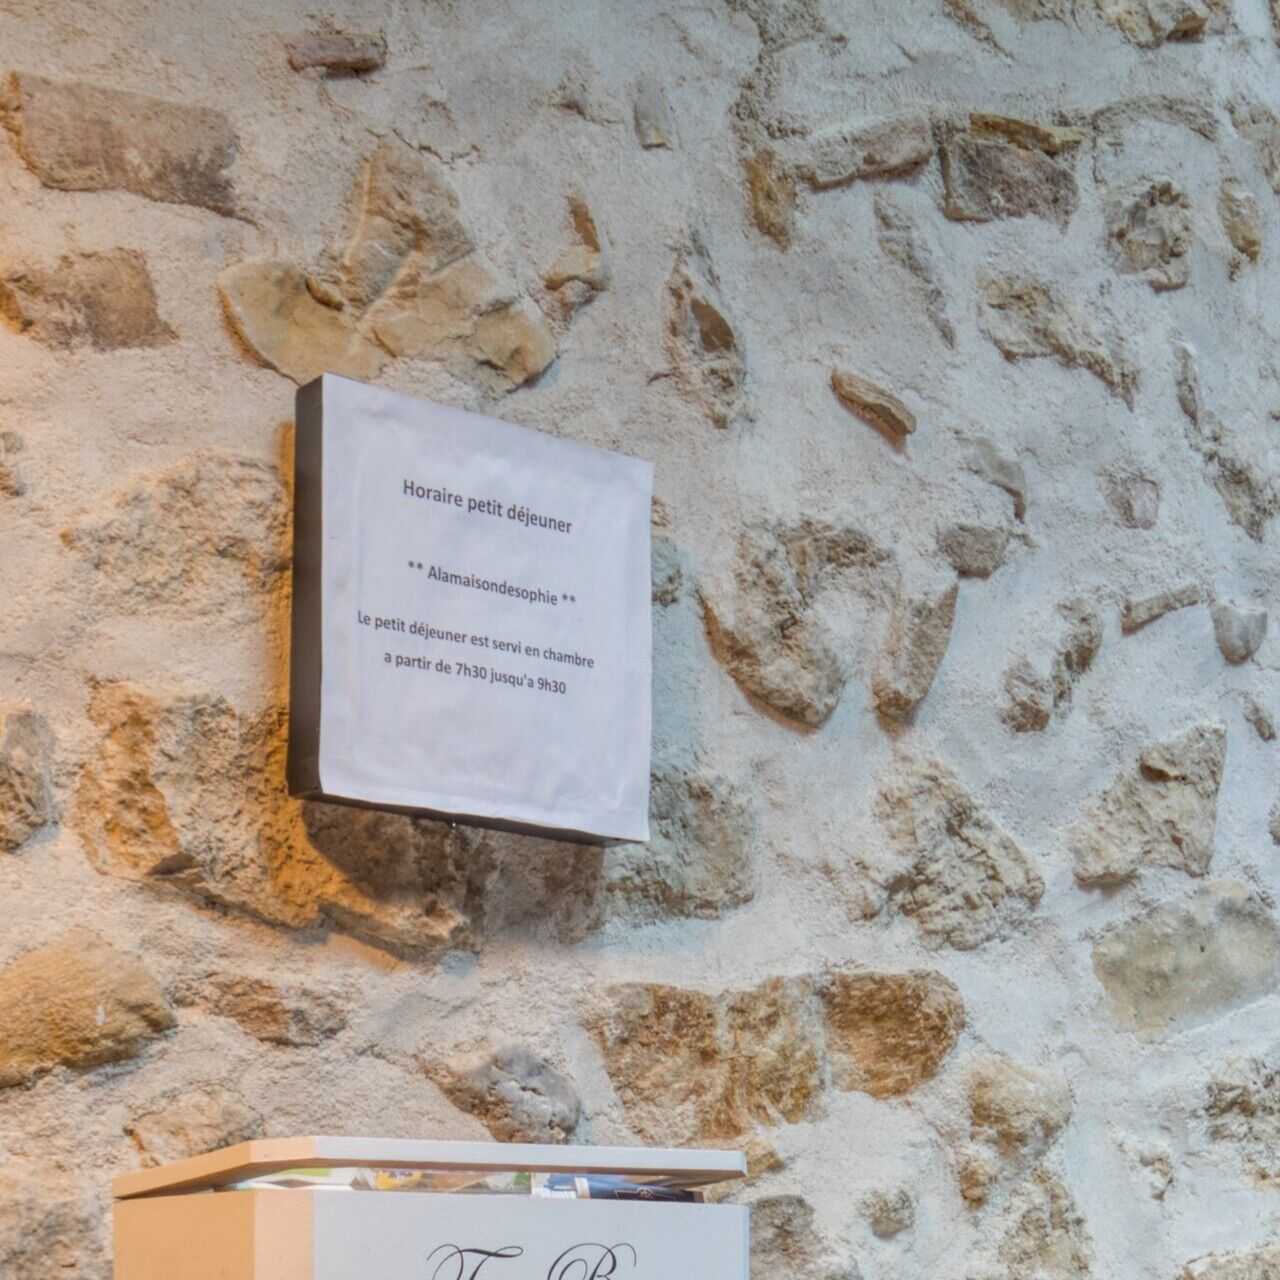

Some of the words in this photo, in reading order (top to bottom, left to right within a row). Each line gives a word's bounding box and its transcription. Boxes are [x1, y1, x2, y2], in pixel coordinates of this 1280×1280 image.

[403, 479, 463, 507] Horaire
[467, 497, 503, 518] petit
[507, 504, 572, 534] déjeuner
[427, 565, 558, 606] Alamaisondesophie
[357, 610, 371, 626] Le
[374, 615, 406, 633] petit
[409, 619, 467, 644] déjeuner
[470, 633, 489, 648] est
[492, 638, 522, 655] servi
[524, 644, 540, 658] en
[542, 646, 595, 669] chambre
[383, 651, 392, 663] a
[395, 654, 432, 672] partir
[435, 659, 452, 674] de
[455, 662, 487, 680] 7h30
[490, 667, 534, 689] jusqu'a
[537, 677, 567, 695] 9h30
